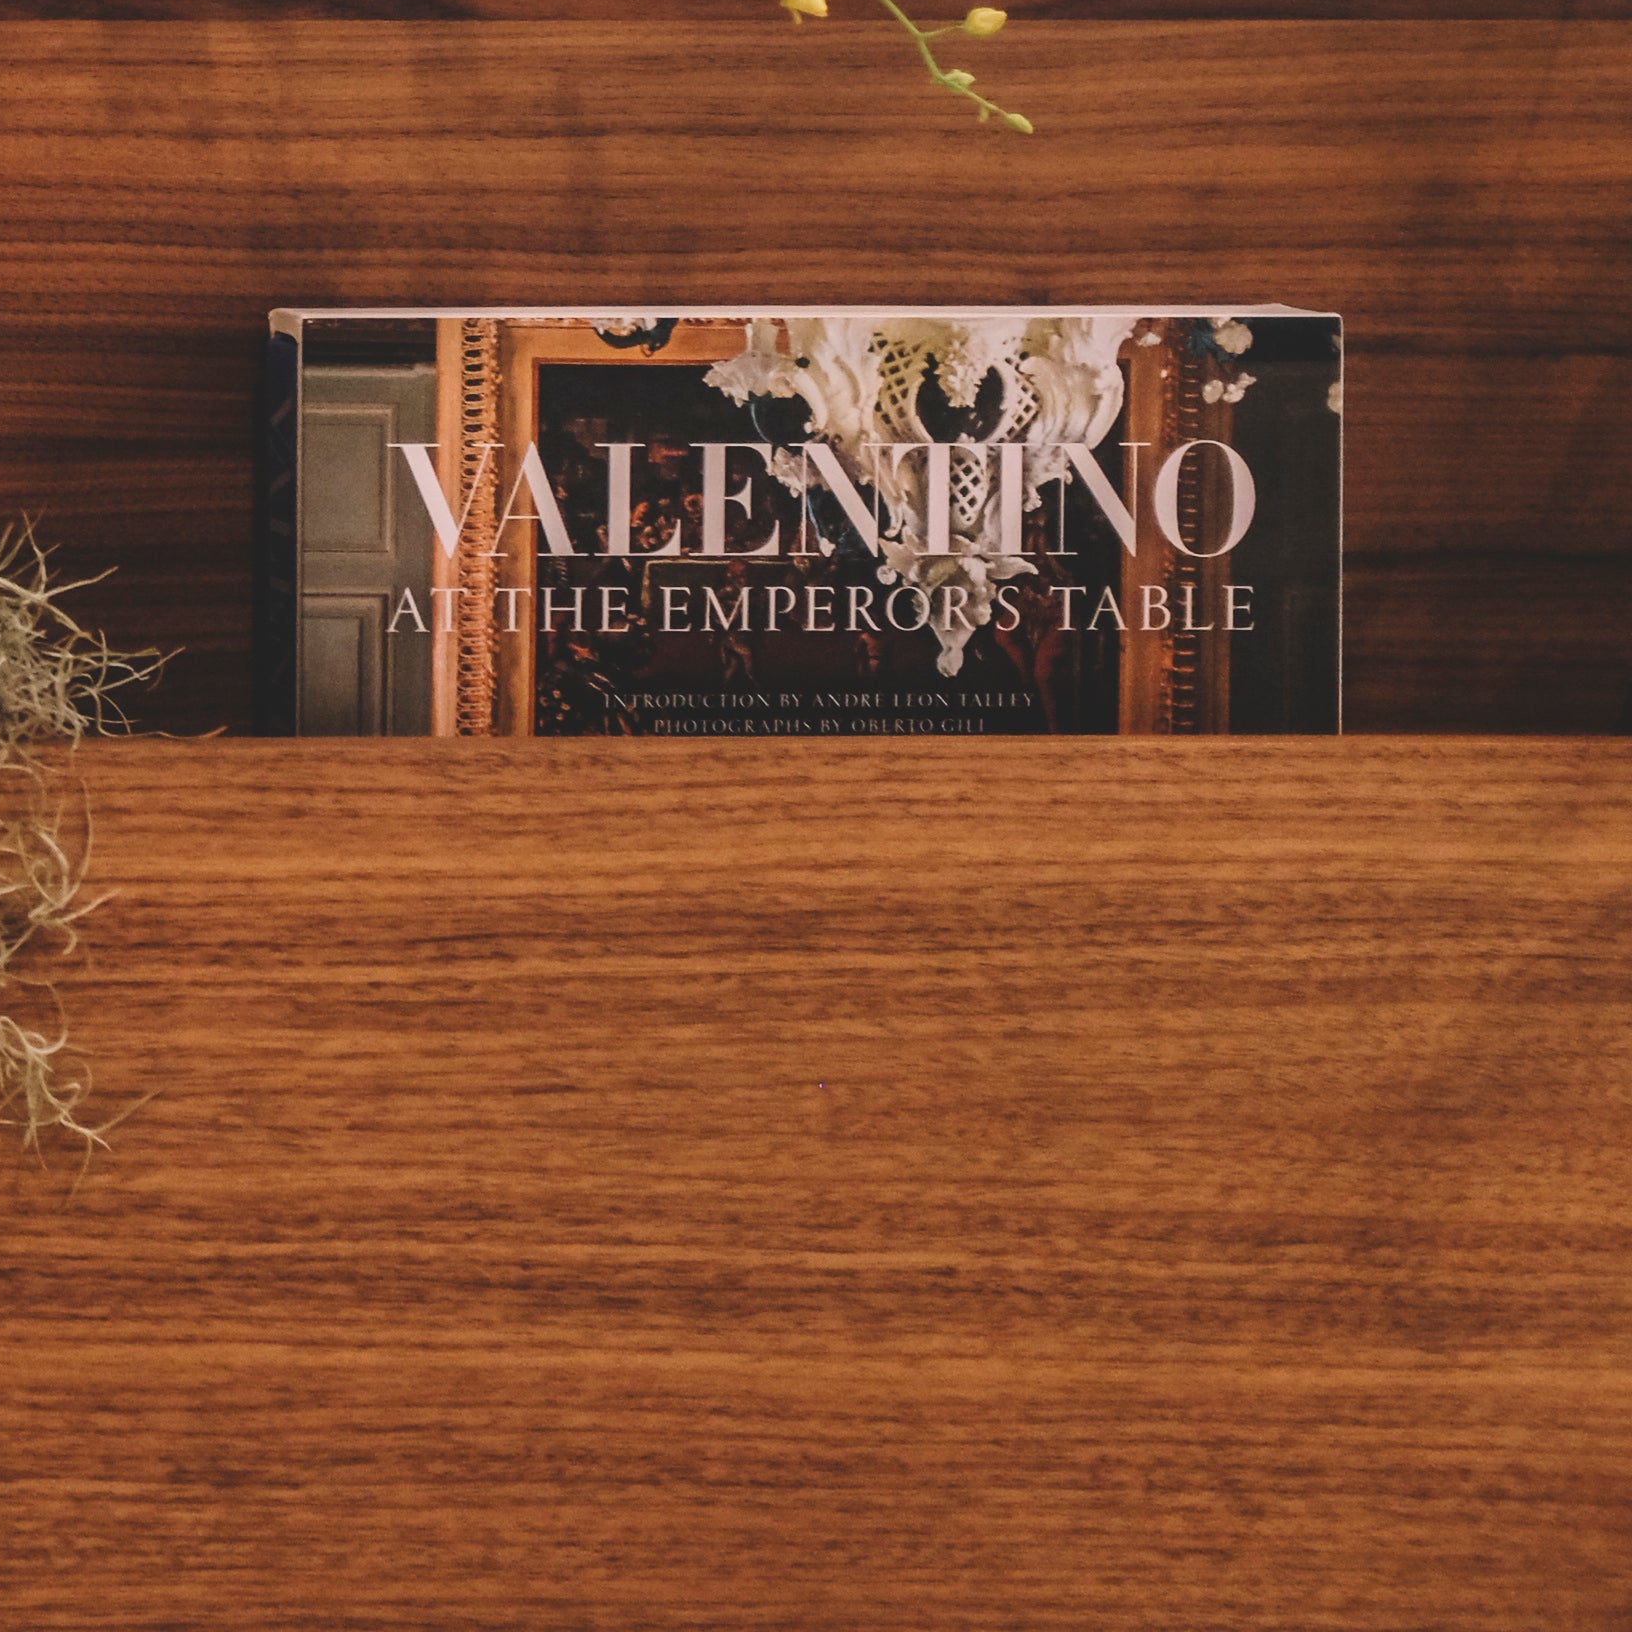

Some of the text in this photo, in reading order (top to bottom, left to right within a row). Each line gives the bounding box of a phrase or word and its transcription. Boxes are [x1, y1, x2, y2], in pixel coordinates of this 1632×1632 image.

[387, 439, 1256, 558] VALENTINO
[385, 585, 1256, 634] AT THE EMPERORS TABLE
[603, 693, 770, 709] INTRODUCTION
[779, 693, 803, 708] BY
[654, 718, 813, 734] PHOTOGRAPHS
[821, 718, 841, 733] BY
[851, 718, 934, 733] OBERTO
